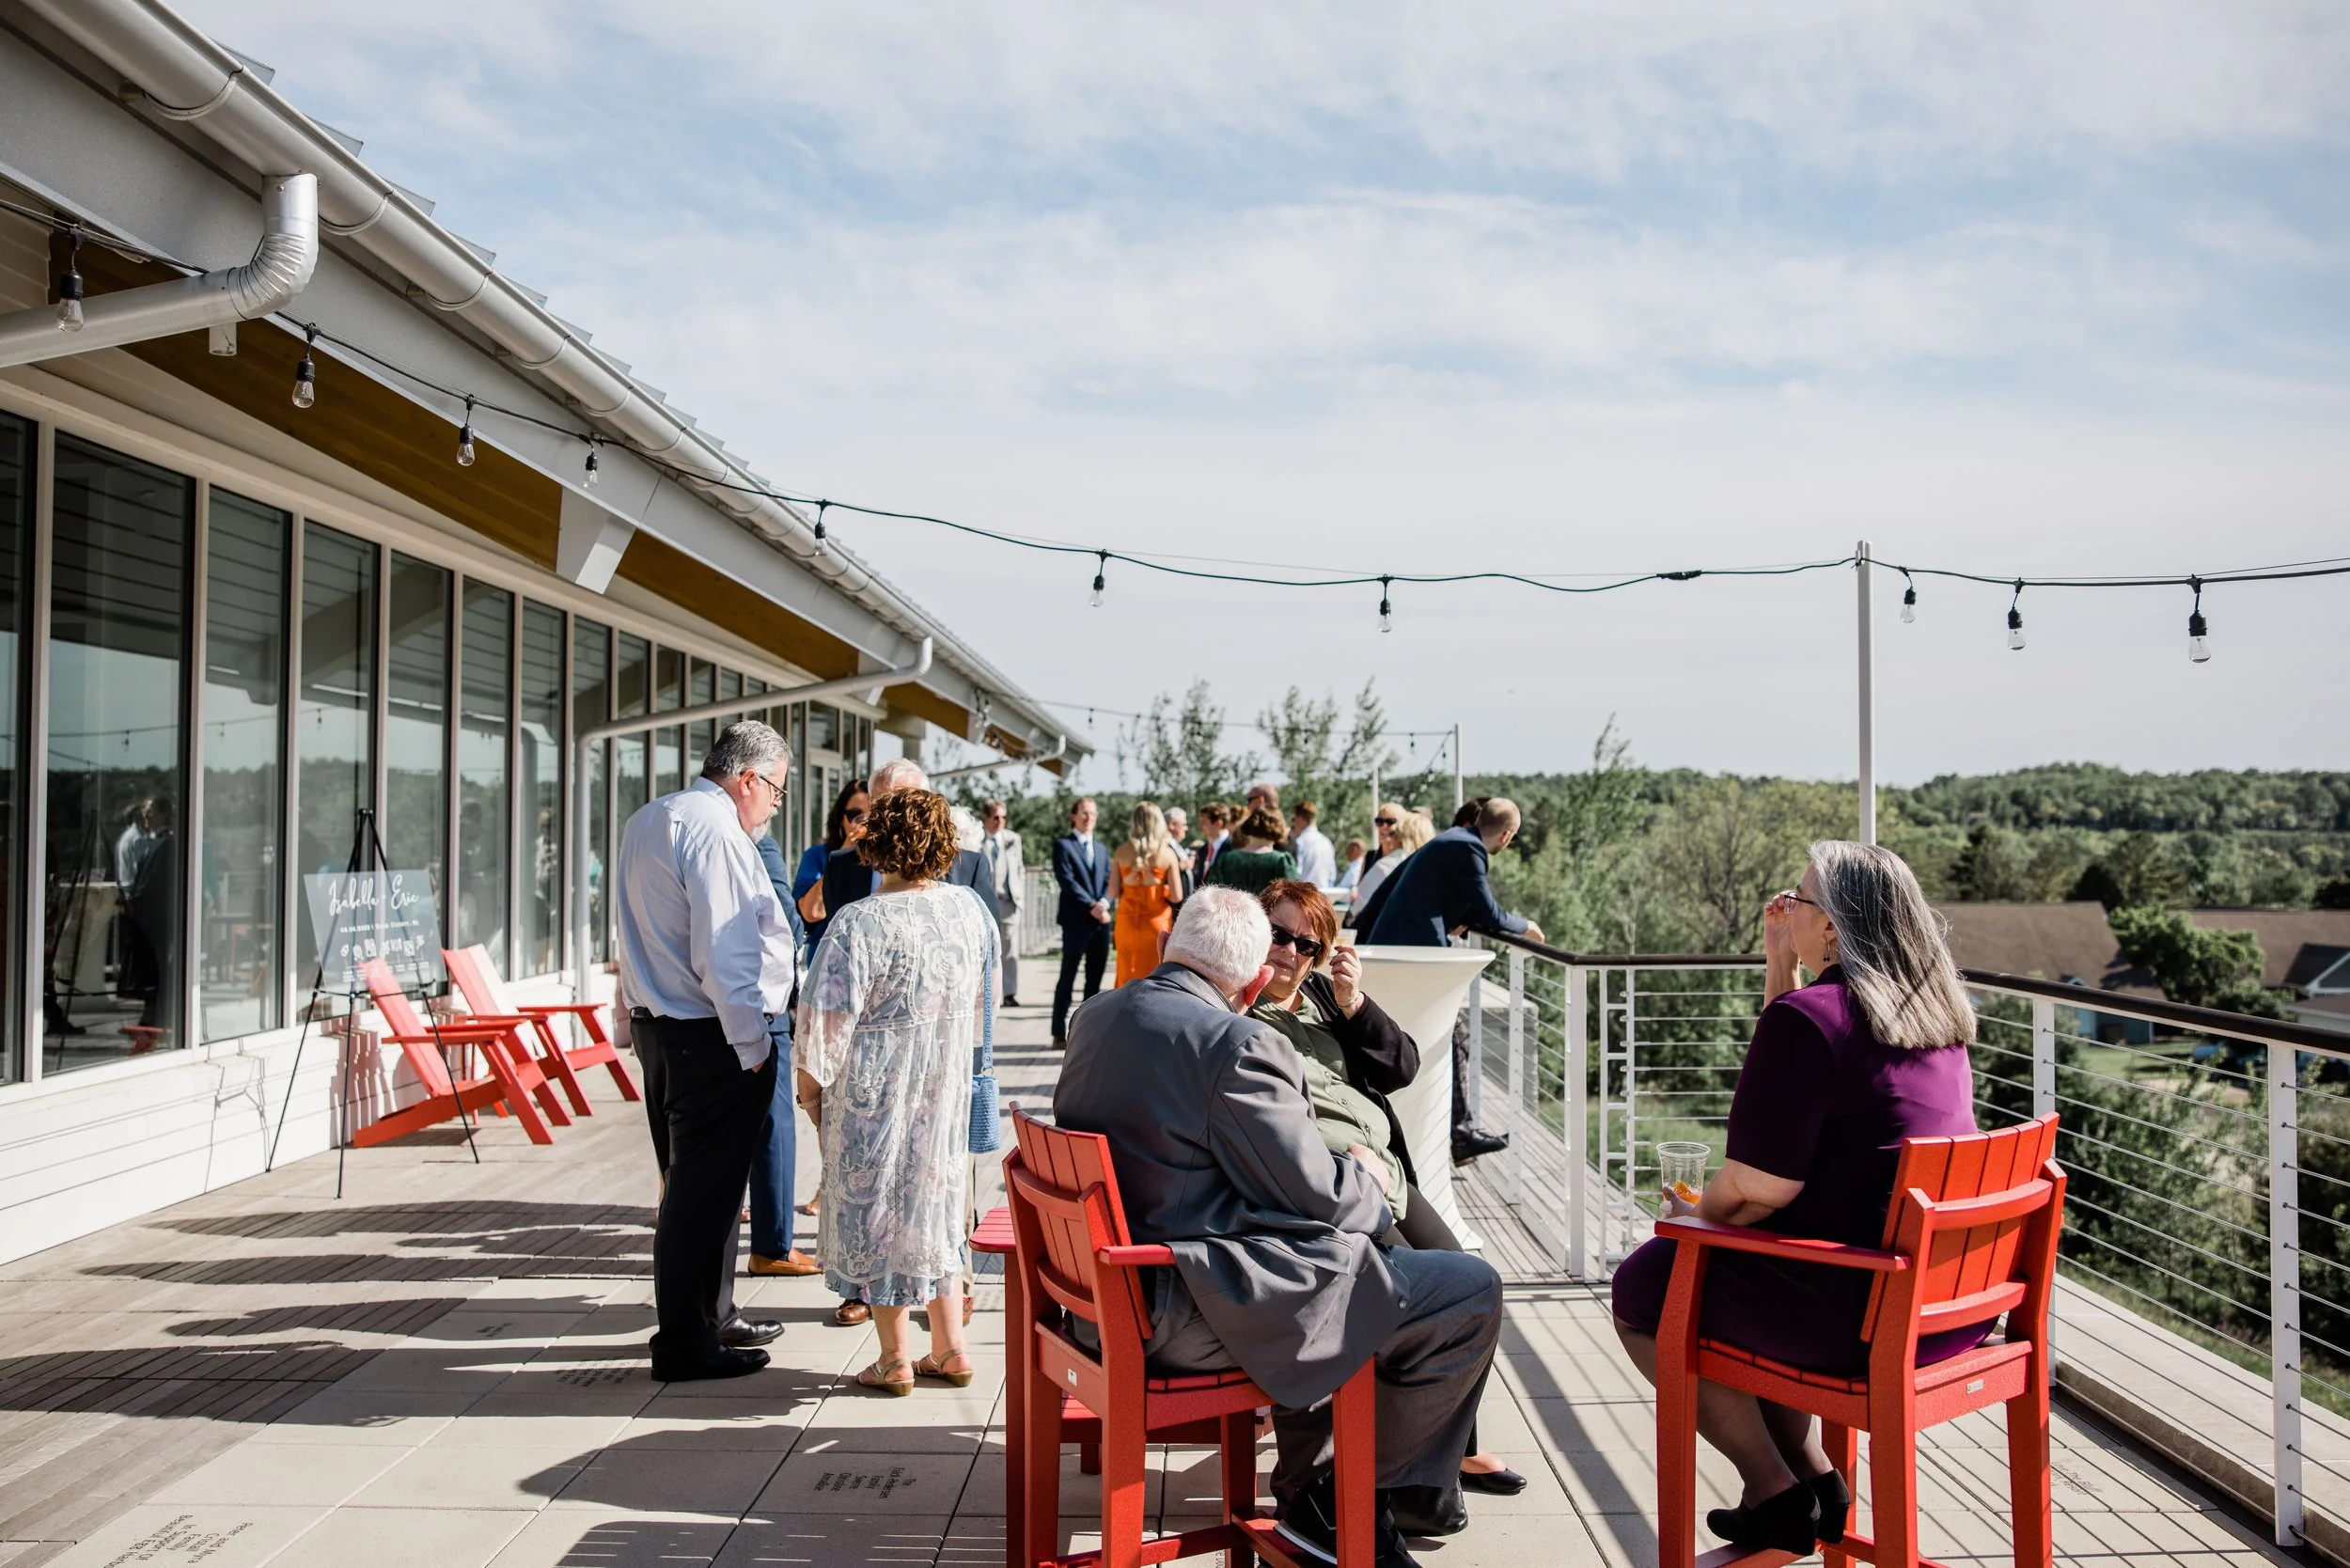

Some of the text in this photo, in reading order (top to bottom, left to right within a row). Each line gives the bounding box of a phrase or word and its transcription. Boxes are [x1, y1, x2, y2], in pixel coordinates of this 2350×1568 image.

[329, 874, 419, 917] Isabella Eric
[149, 1514, 194, 1538] Beautiful
[130, 1539, 156, 1549] Egg
[148, 1530, 187, 1551] Support
[166, 1534, 201, 1550] Family
[187, 1522, 254, 1563] Peter and Myra
